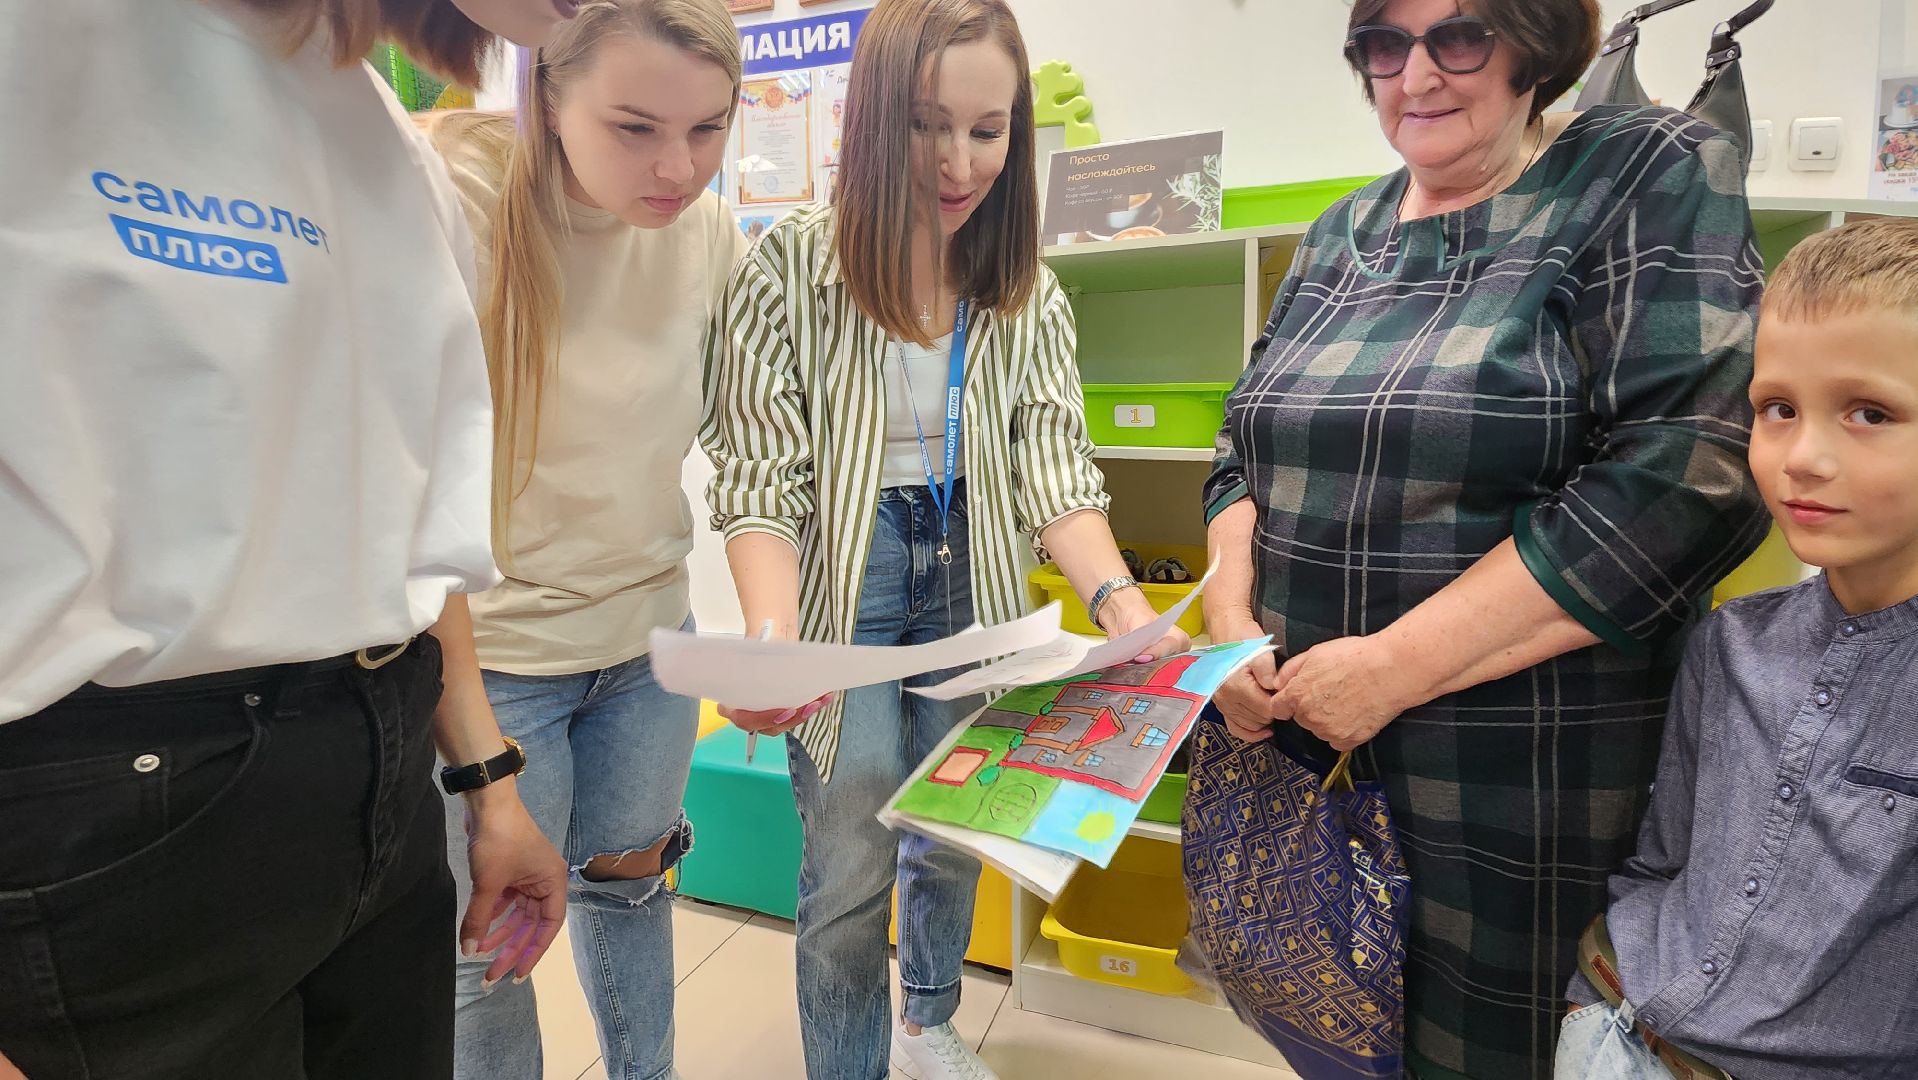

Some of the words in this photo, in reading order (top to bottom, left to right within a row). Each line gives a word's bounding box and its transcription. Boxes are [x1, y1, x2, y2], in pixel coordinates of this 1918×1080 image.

[1069, 153, 1110, 166] Просто
[1067, 163, 1156, 182] наслаждайтесь
[91, 171, 331, 254] самолет
[128, 226, 274, 275] плюс
[950, 388, 959, 417] плюс
[1130, 407, 1141, 424] 1
[946, 421, 957, 475] самолет
[1108, 958, 1130, 973] 16
